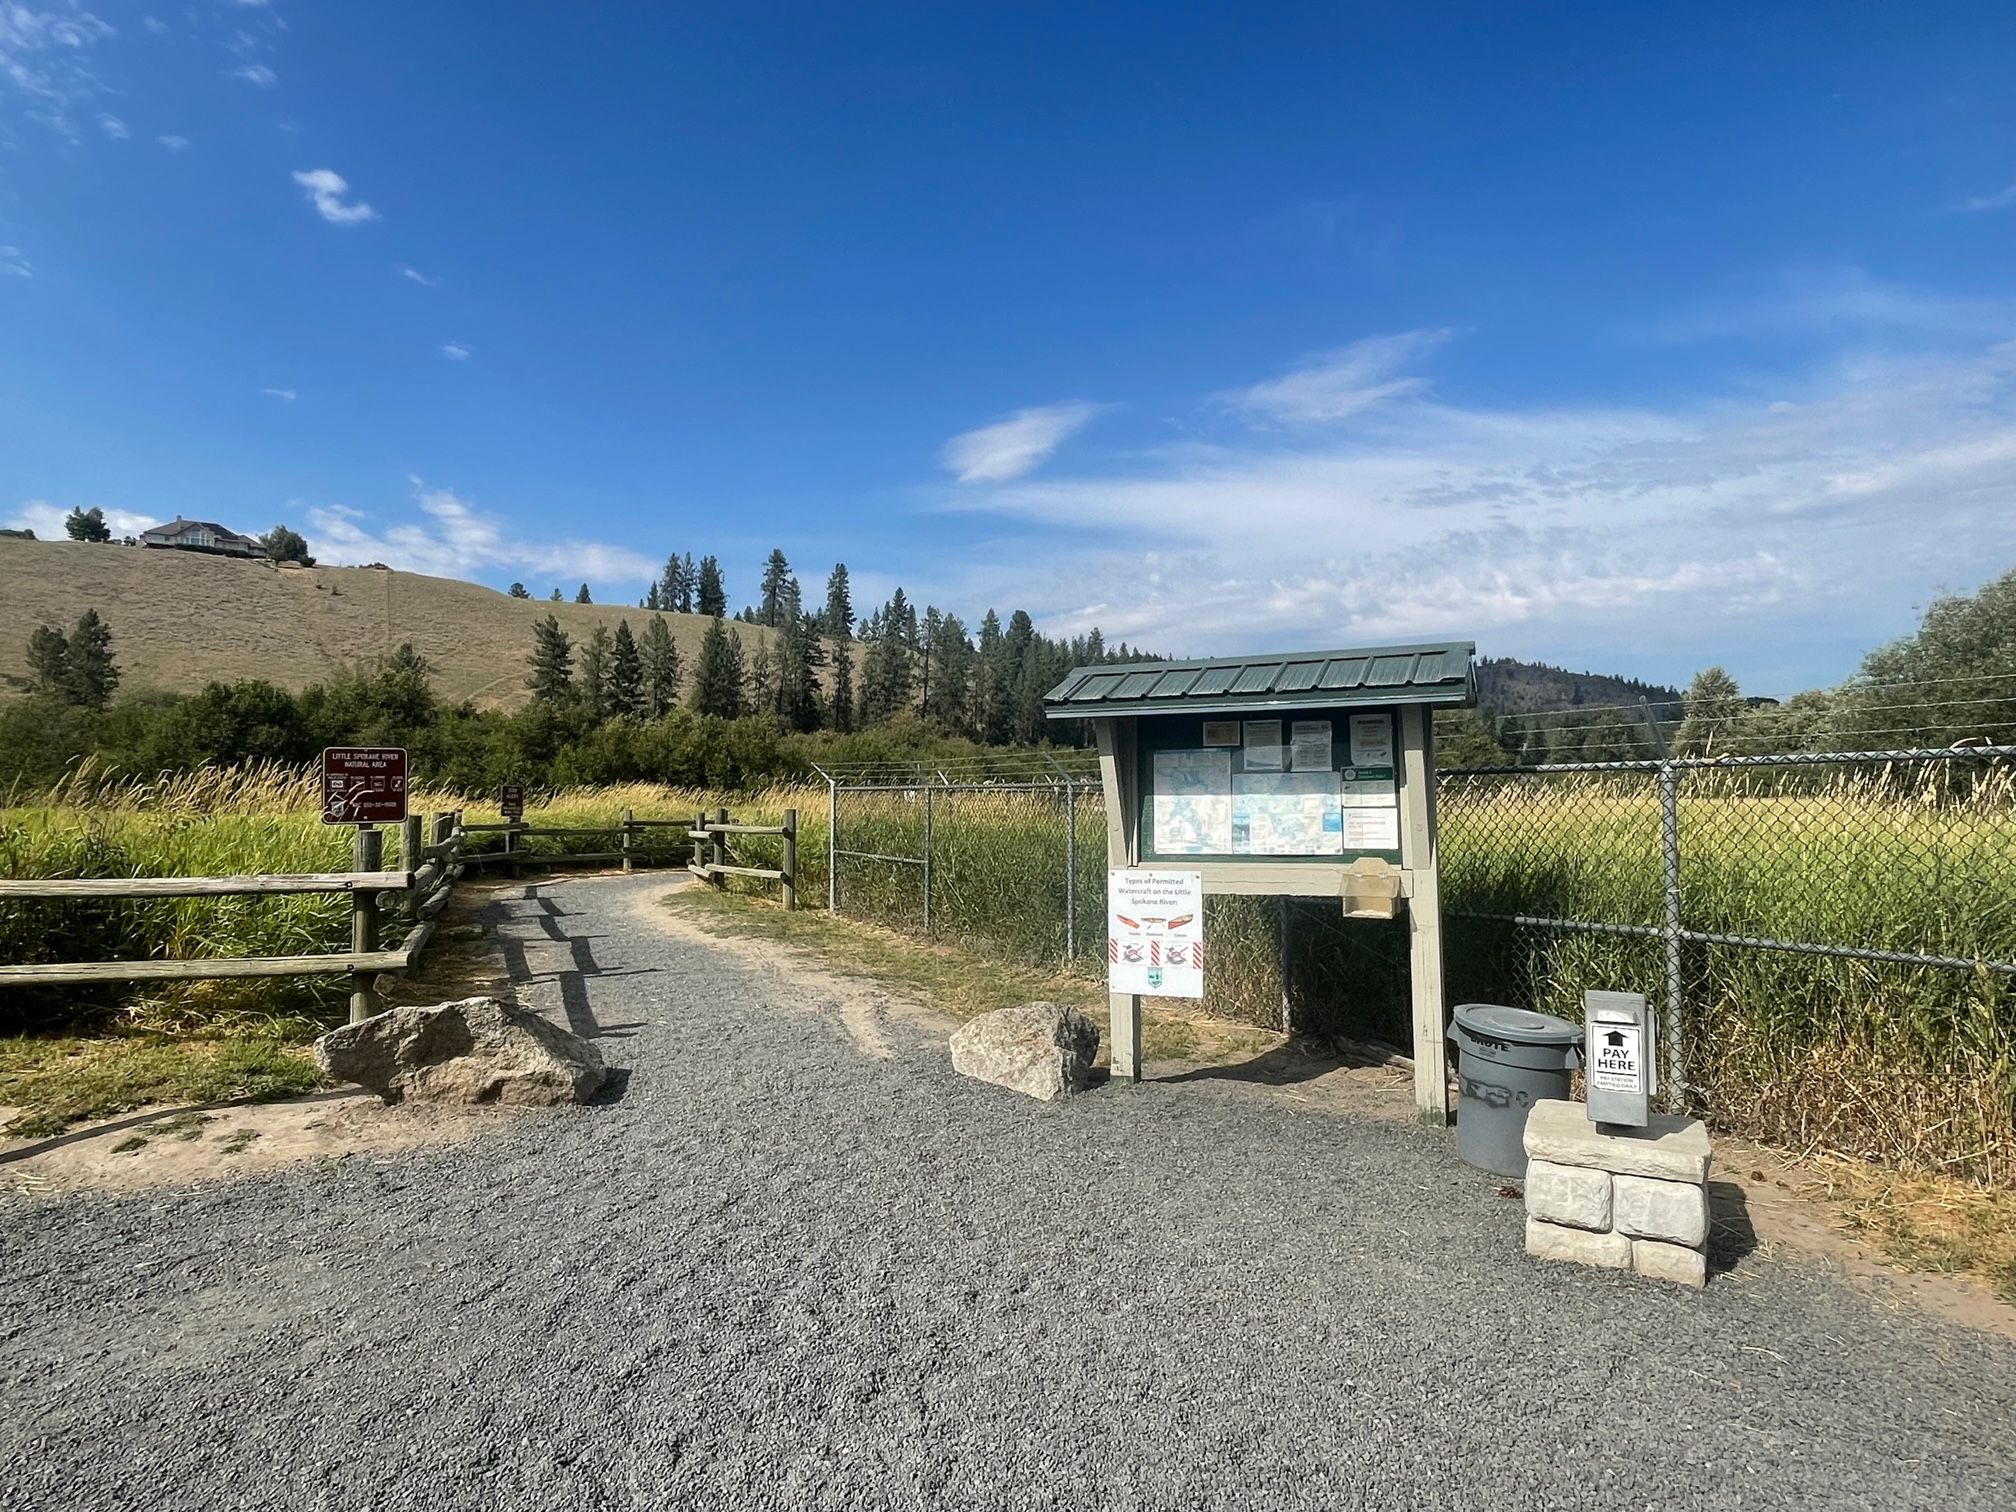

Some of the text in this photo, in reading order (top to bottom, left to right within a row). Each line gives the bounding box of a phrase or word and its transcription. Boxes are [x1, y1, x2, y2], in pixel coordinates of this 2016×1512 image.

[1125, 878, 1143, 886] Types
[1118, 887, 1151, 895] Watercraft
[1131, 898, 1158, 906] Spokane
[1603, 1048, 1629, 1059] PAY
[1598, 1058, 1636, 1071] HERE
